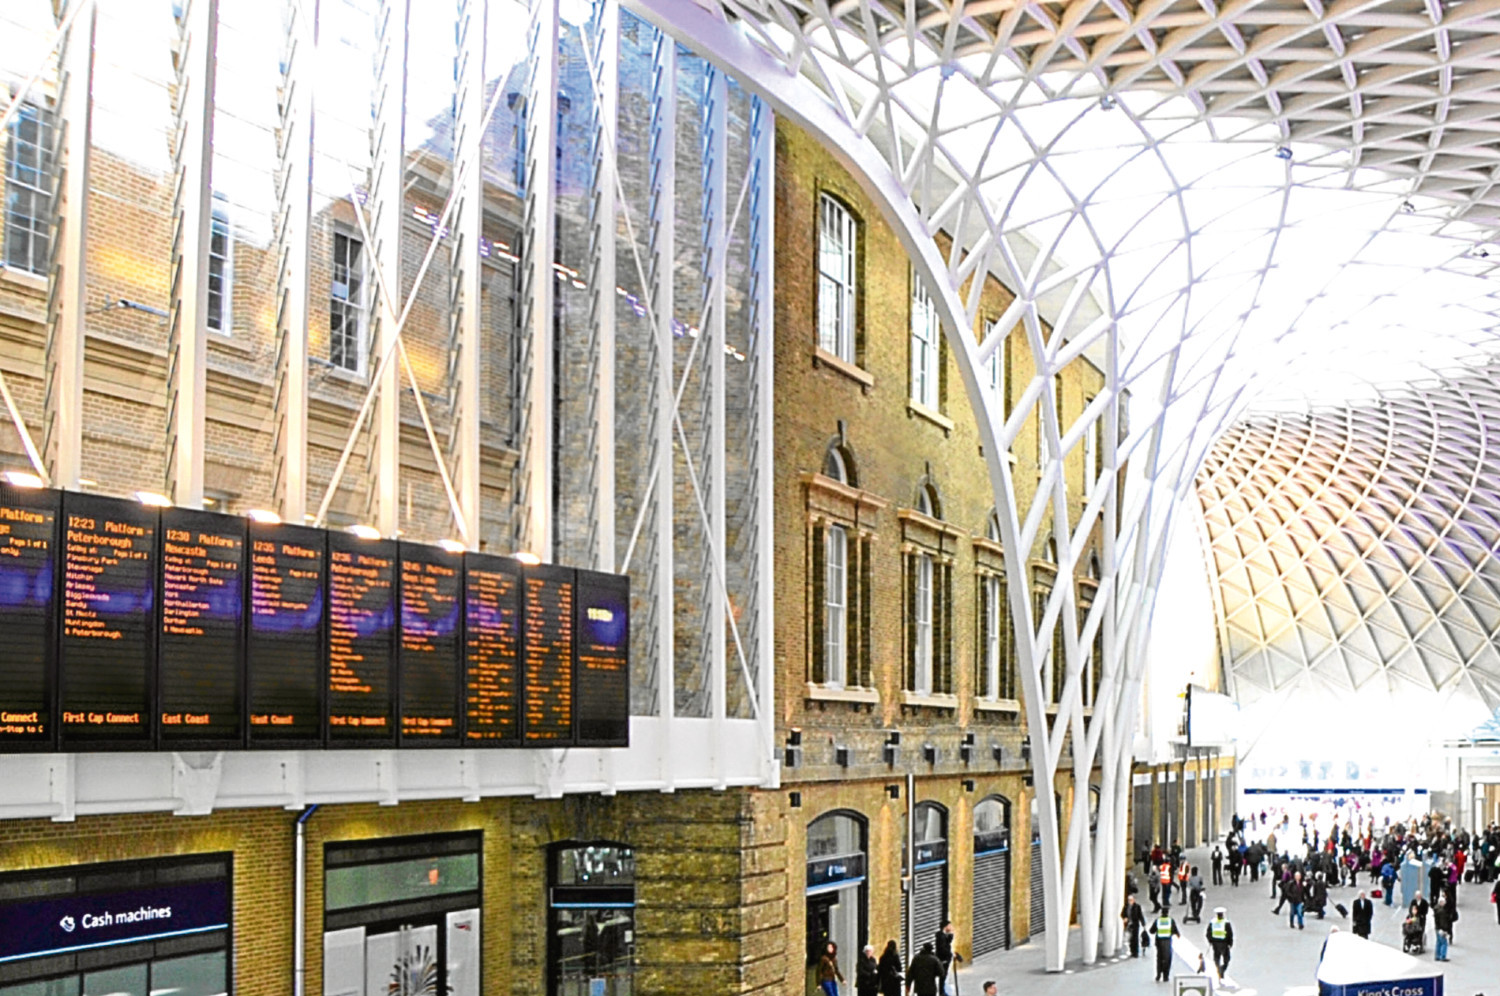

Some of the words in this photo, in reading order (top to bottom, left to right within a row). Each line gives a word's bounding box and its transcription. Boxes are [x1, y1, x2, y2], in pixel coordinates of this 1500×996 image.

[69, 516, 95, 530] 12:23
[105, 521, 144, 536] Platform
[67, 530, 132, 549] Peterborough
[199, 533, 234, 548] Platform
[165, 542, 207, 557] Newcastle
[1, 712, 38, 723] Connect
[63, 712, 85, 723] First
[88, 712, 104, 725] Cap
[106, 712, 140, 723] Connect
[162, 713, 182, 724] East
[185, 713, 210, 724] Coast
[82, 911, 113, 928] Cash
[115, 906, 171, 924] machines
